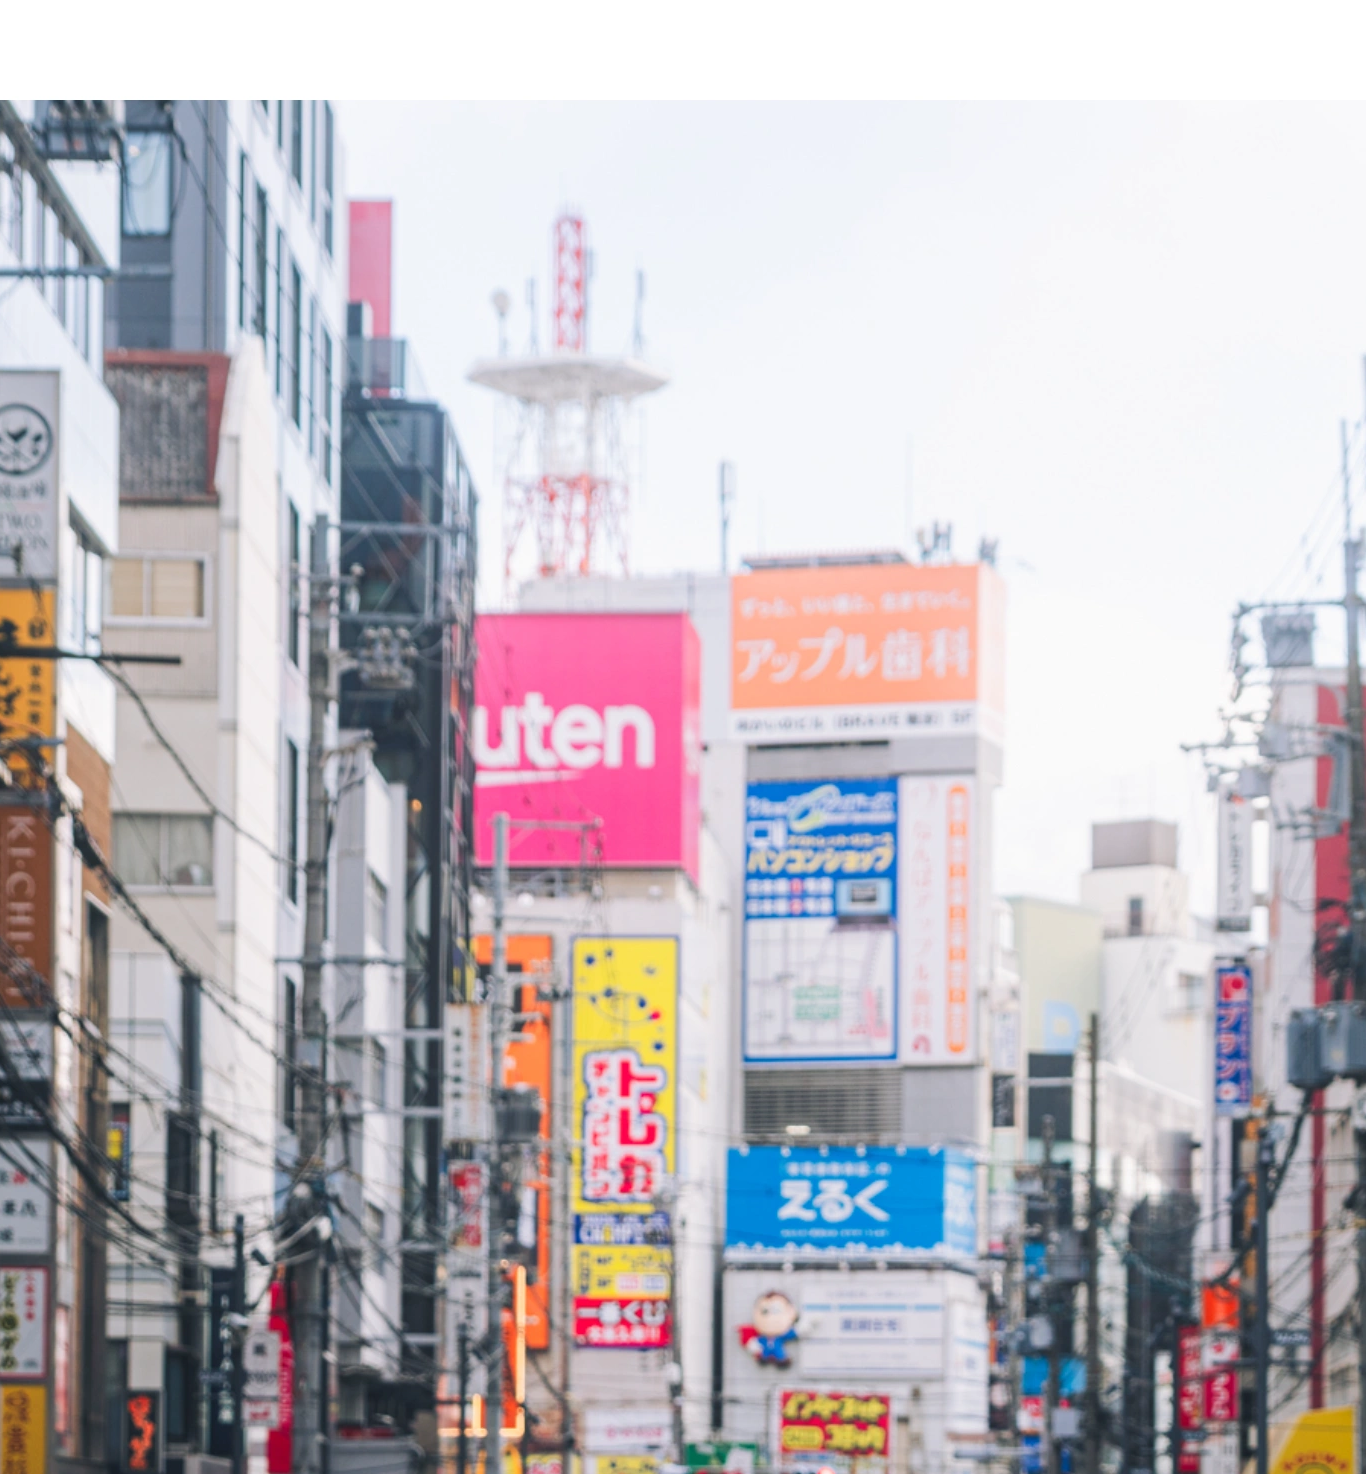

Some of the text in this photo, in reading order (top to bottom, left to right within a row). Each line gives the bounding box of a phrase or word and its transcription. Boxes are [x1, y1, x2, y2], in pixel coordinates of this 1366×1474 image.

[736, 625, 971, 684] アップル歯科
[776, 1179, 891, 1223] えるく
